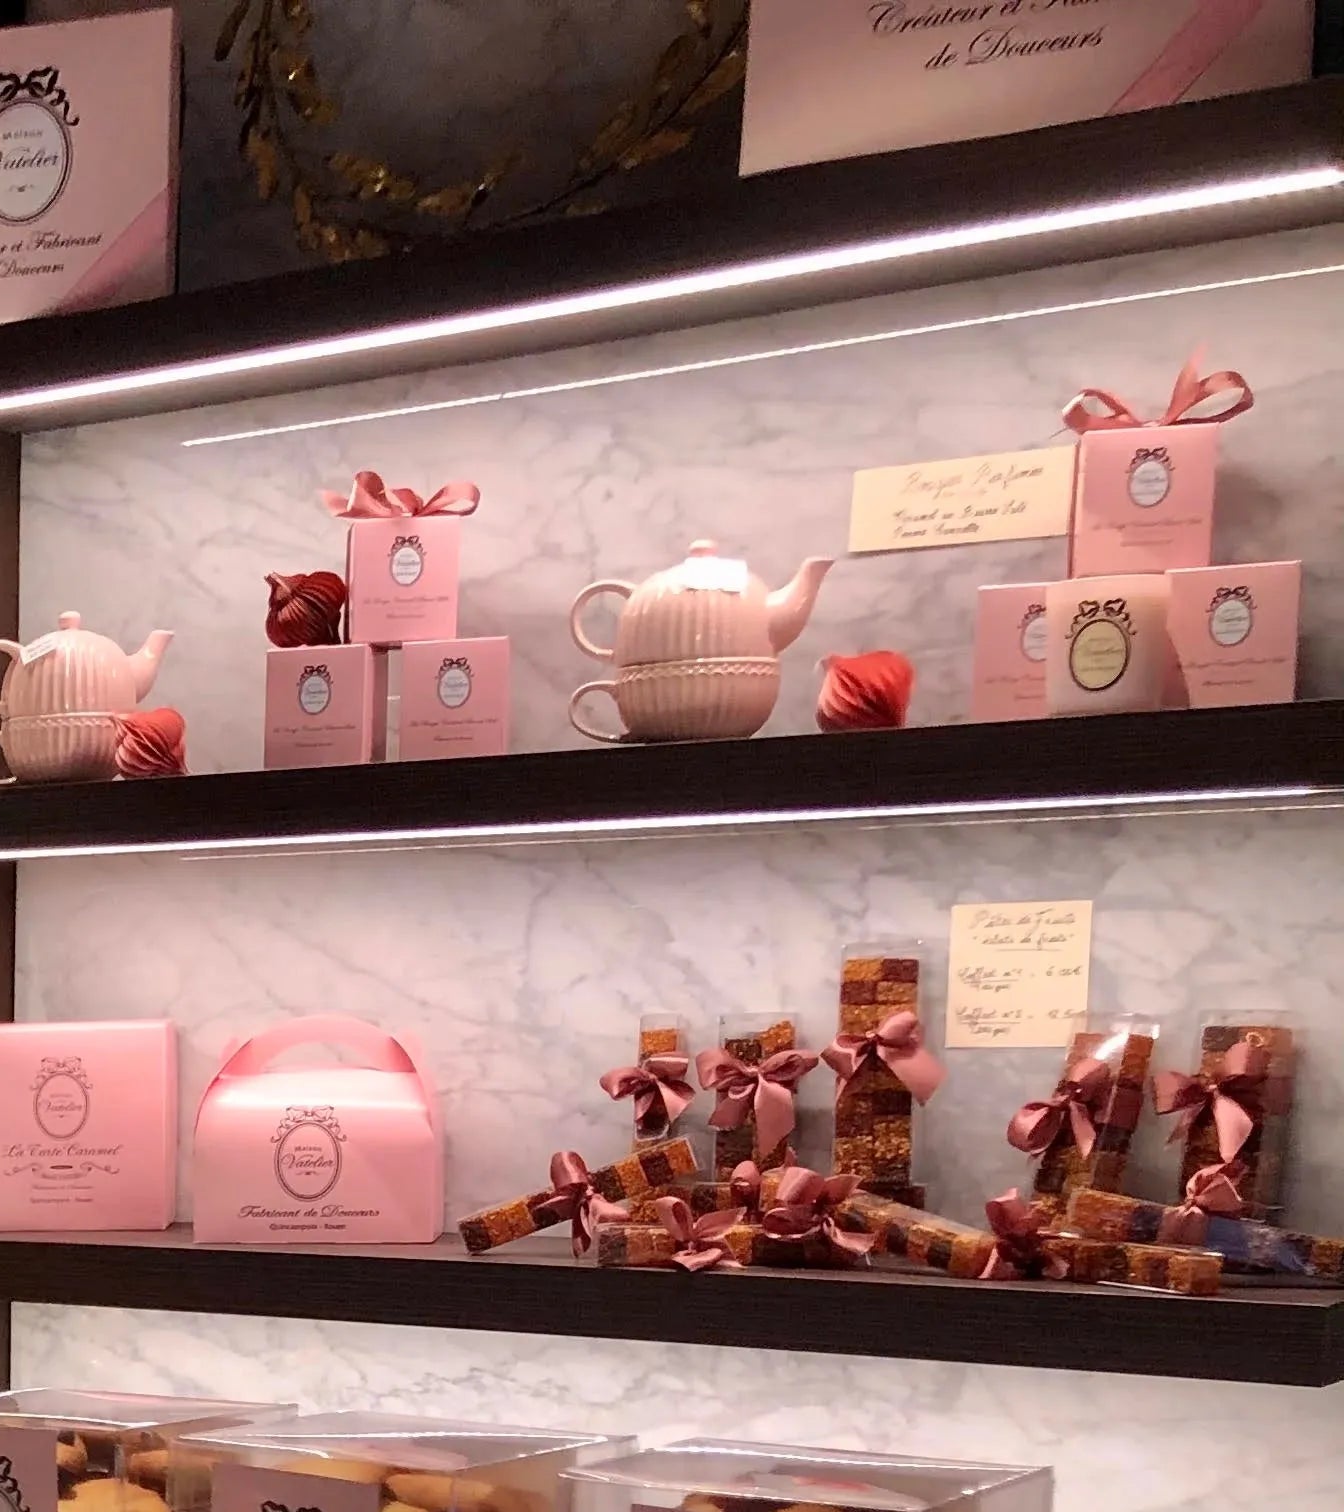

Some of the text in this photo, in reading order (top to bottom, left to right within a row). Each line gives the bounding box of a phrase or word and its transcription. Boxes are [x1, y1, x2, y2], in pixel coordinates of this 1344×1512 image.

[924, 24, 1108, 71] de Douceurs
[27, 231, 103, 250] Fabricant
[63, 1142, 124, 1158] Caramel
[280, 1153, 336, 1170] Vatelier
[238, 1204, 381, 1220] Fabricant de Douceurs
